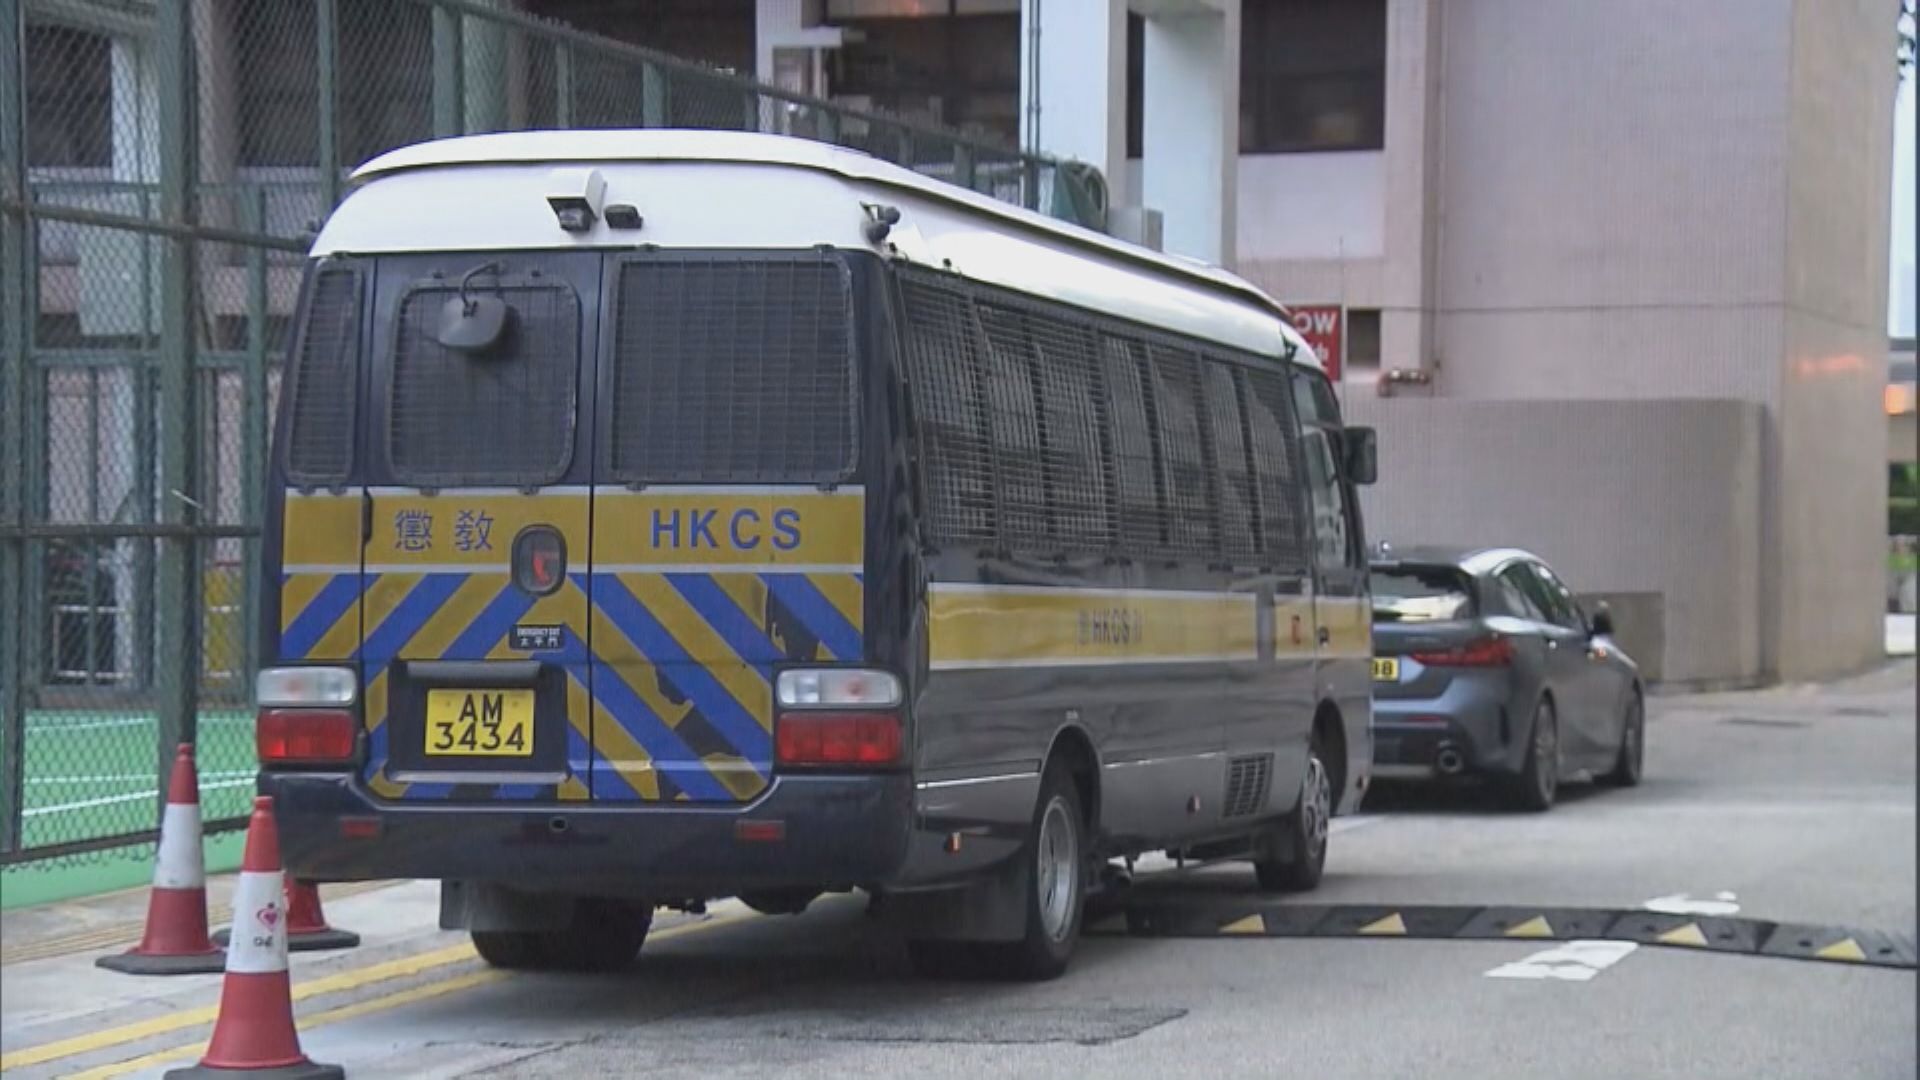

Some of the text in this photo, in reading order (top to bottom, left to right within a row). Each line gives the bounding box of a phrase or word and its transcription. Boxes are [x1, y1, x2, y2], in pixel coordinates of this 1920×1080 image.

[1295, 311, 1338, 334] OW
[652, 508, 801, 550] HKCS
[1092, 608, 1131, 644] HKCS
[459, 693, 503, 721] AM
[434, 722, 524, 750] 3434
